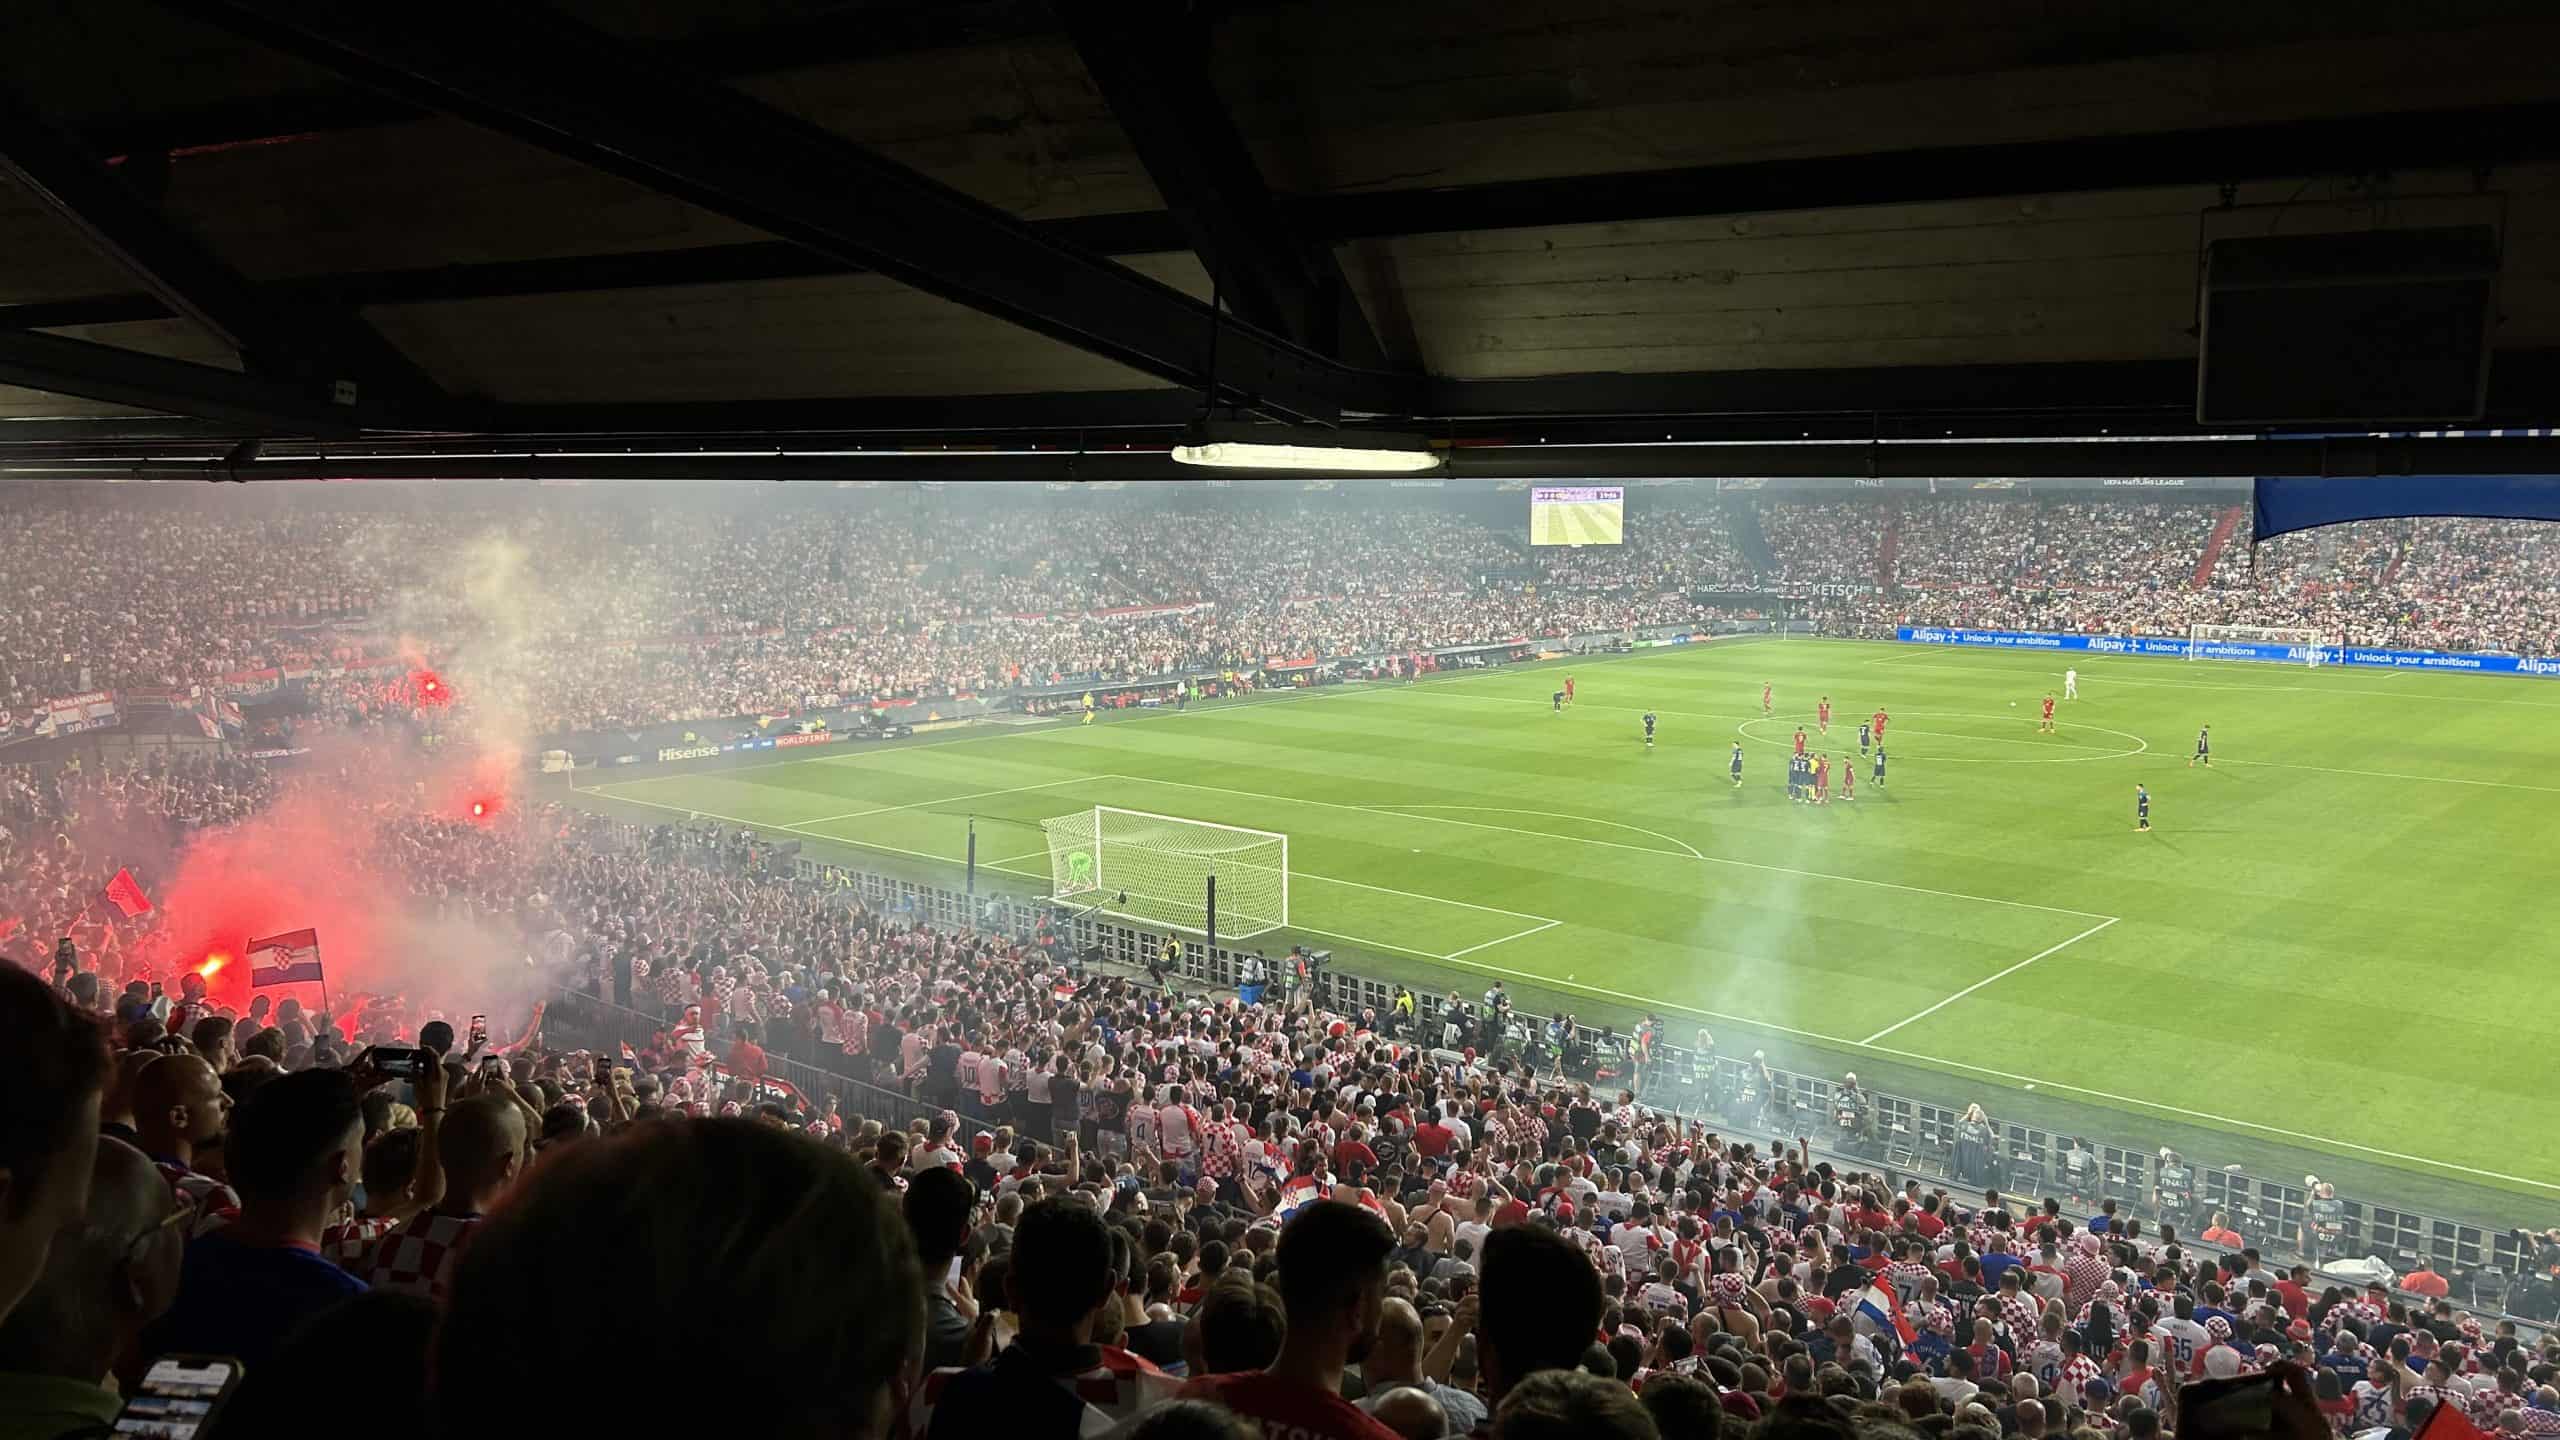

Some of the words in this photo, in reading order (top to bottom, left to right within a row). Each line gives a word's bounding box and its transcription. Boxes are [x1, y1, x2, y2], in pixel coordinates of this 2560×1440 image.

[1962, 634, 1993, 643] Unlock
[1993, 637, 2014, 646] your
[2016, 636, 2060, 646] ambitions
[2145, 642, 2179, 652] Unlock
[2205, 646, 2256, 656] ambitions
[2354, 652, 2392, 663] Unlock
[2394, 655, 2420, 666] your
[2423, 655, 2481, 668] ambitions
[776, 733, 832, 747] WORLDFIRST
[658, 745, 720, 761] Hisense
[962, 1065, 976, 1082] 10
